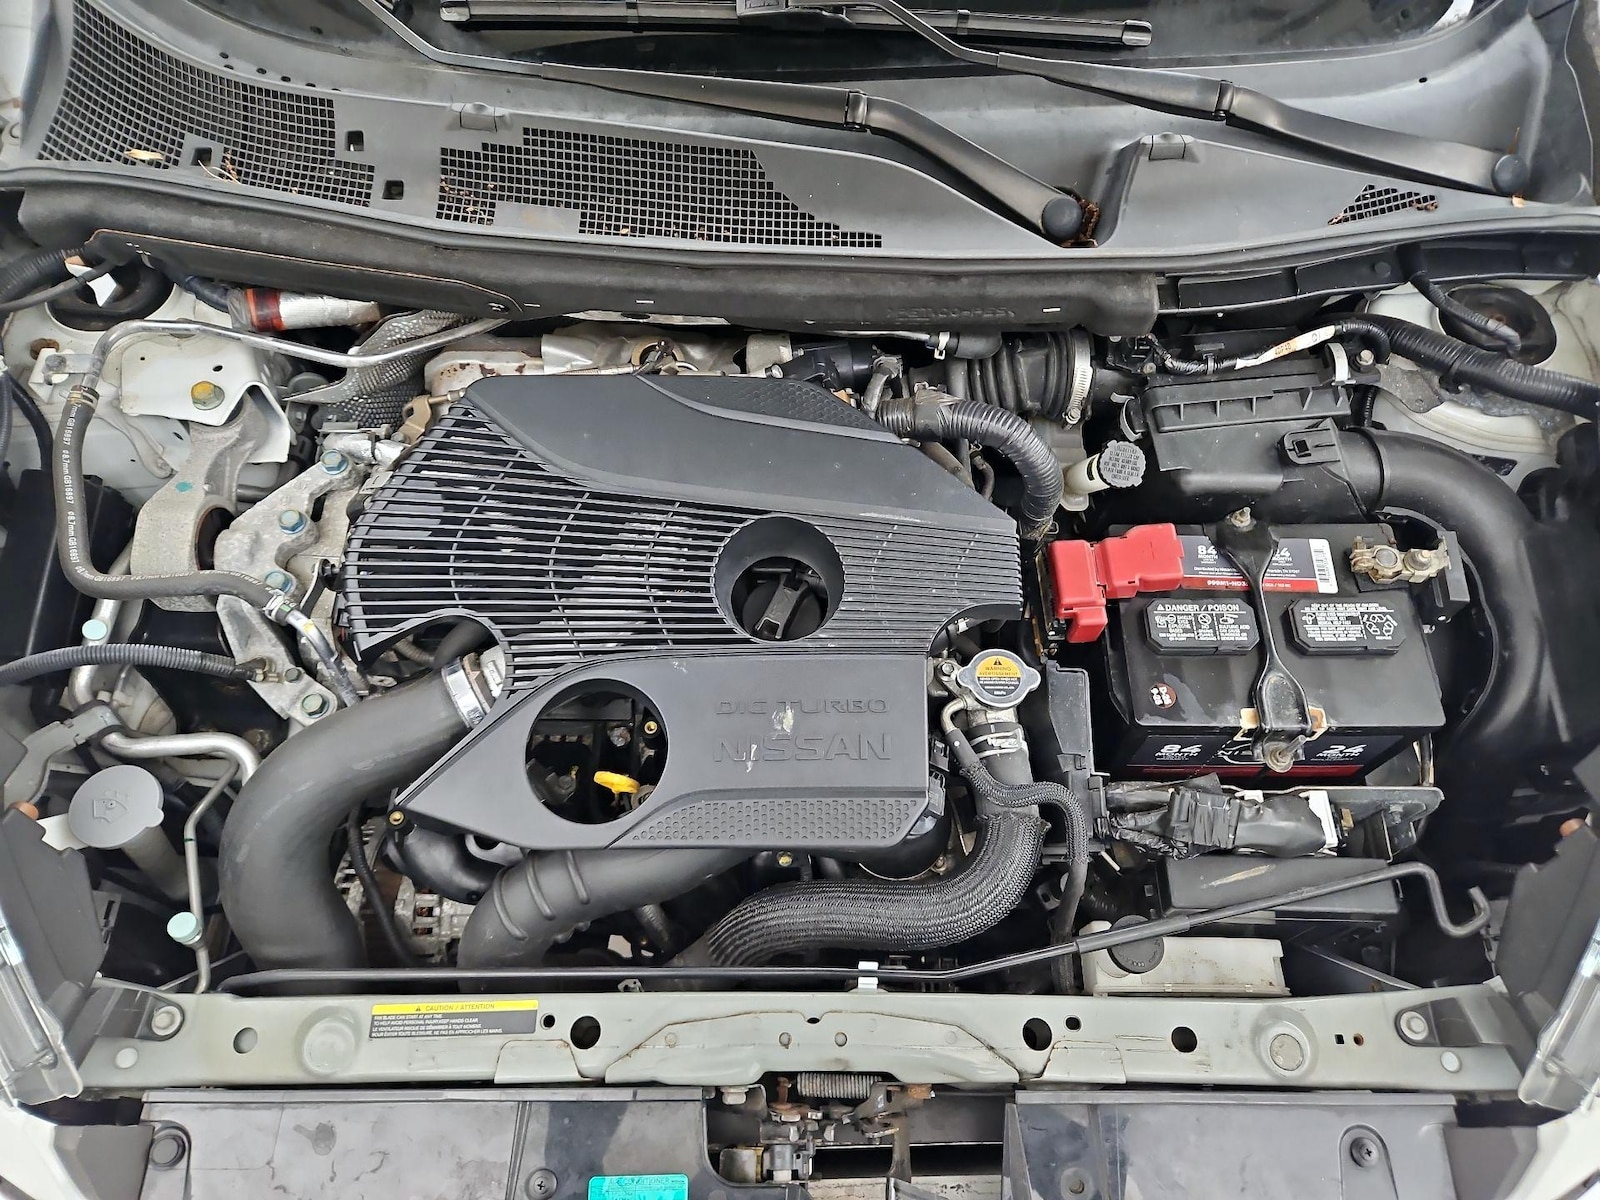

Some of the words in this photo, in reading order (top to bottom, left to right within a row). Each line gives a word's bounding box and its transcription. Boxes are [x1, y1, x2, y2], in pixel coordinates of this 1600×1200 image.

[1197, 545, 1217, 555] 84
[1165, 604, 1200, 612] DANGER
[1208, 603, 1240, 611] POISON
[776, 698, 890, 714] TURBO
[713, 733, 892, 762] NISSAN
[1160, 744, 1203, 753] 84
[1322, 744, 1368, 754] 24
[425, 1004, 454, 1012] CAUTION
